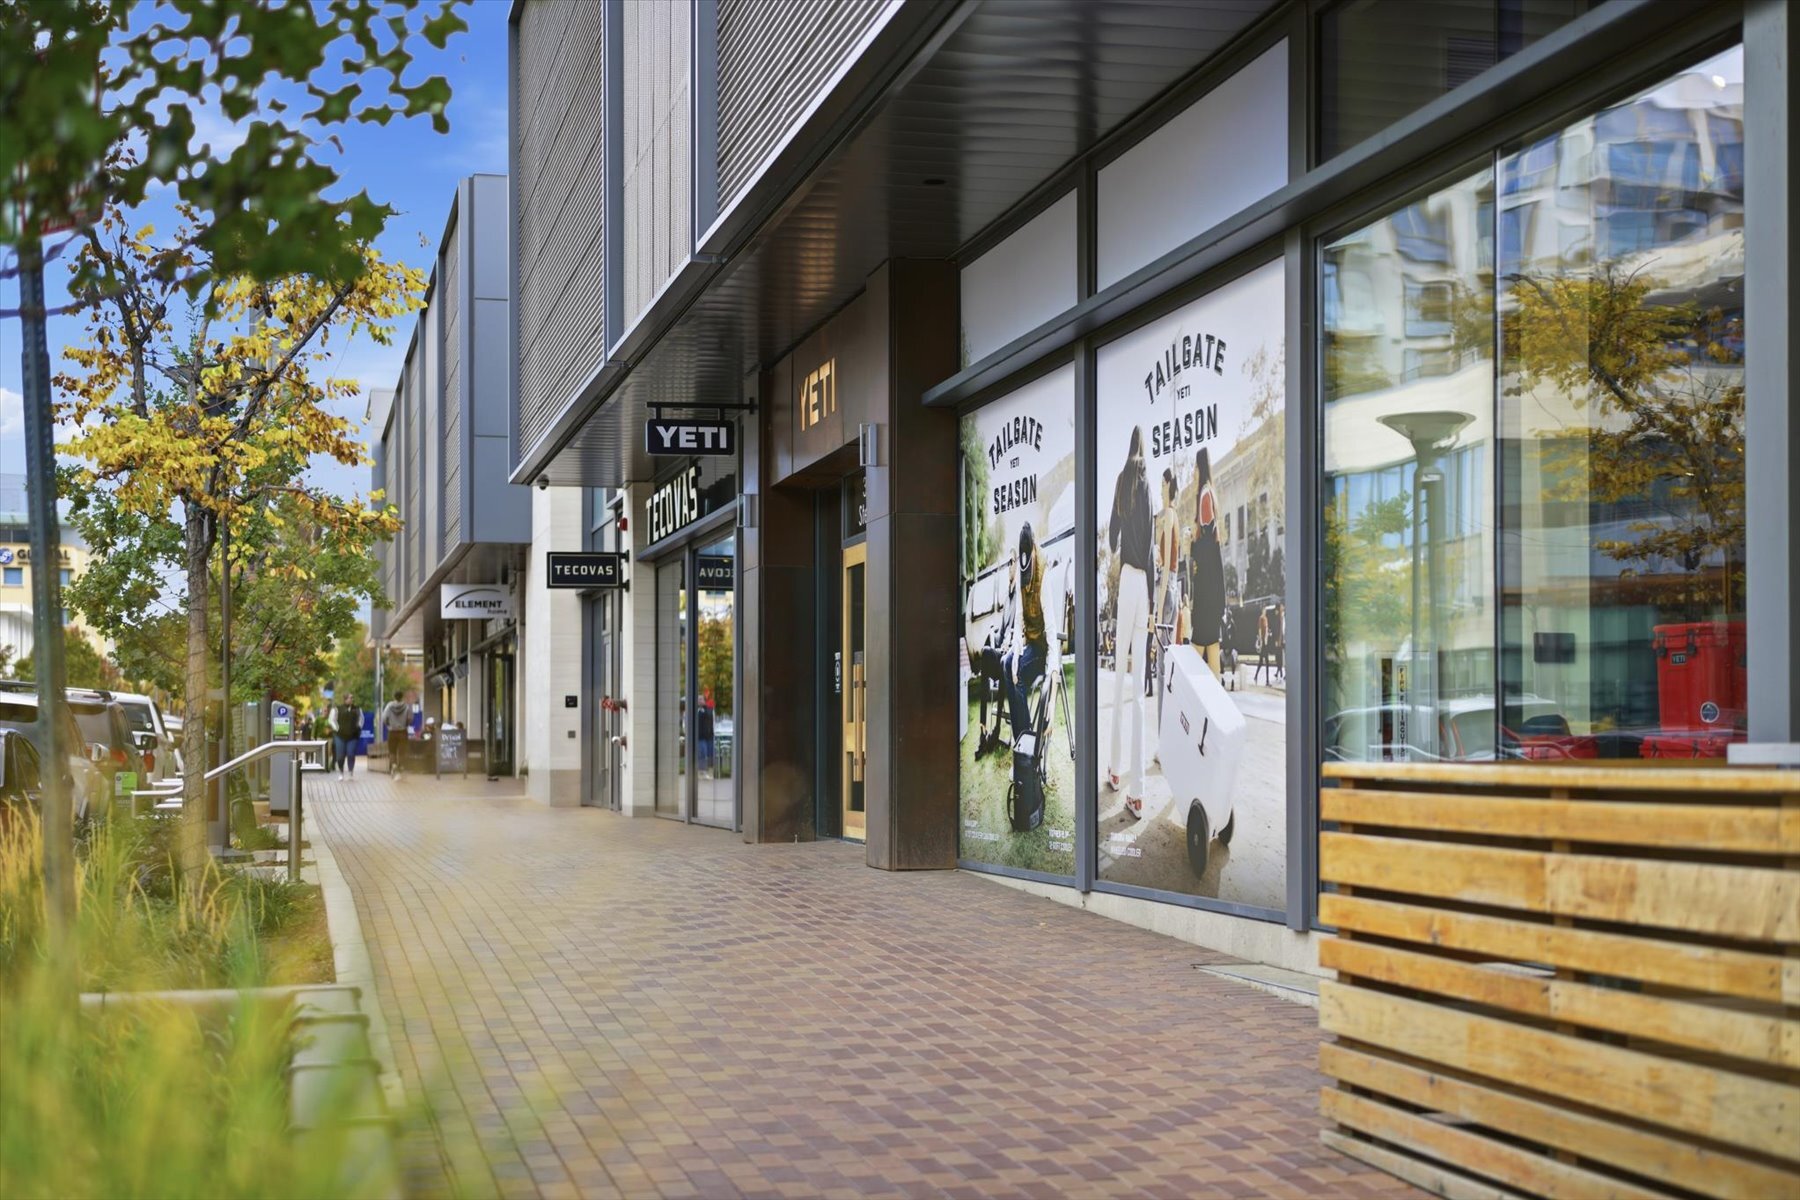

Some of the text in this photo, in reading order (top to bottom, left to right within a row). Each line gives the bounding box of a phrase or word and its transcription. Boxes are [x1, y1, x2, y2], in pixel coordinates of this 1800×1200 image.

[1145, 333, 1227, 404] TAILGATE
[798, 357, 836, 431] YETI
[1177, 385, 1191, 400] YETI
[655, 426, 727, 448] YETI
[989, 415, 1043, 470] TAILGATE
[1152, 403, 1217, 458] SEASON
[1010, 456, 1020, 469] YETI
[645, 466, 698, 546] TECOVAS
[994, 473, 1037, 515] SEASON
[554, 565, 614, 576] TECOVAS
[455, 600, 503, 609] ELEMENT
[1672, 654, 1687, 664] YETI
